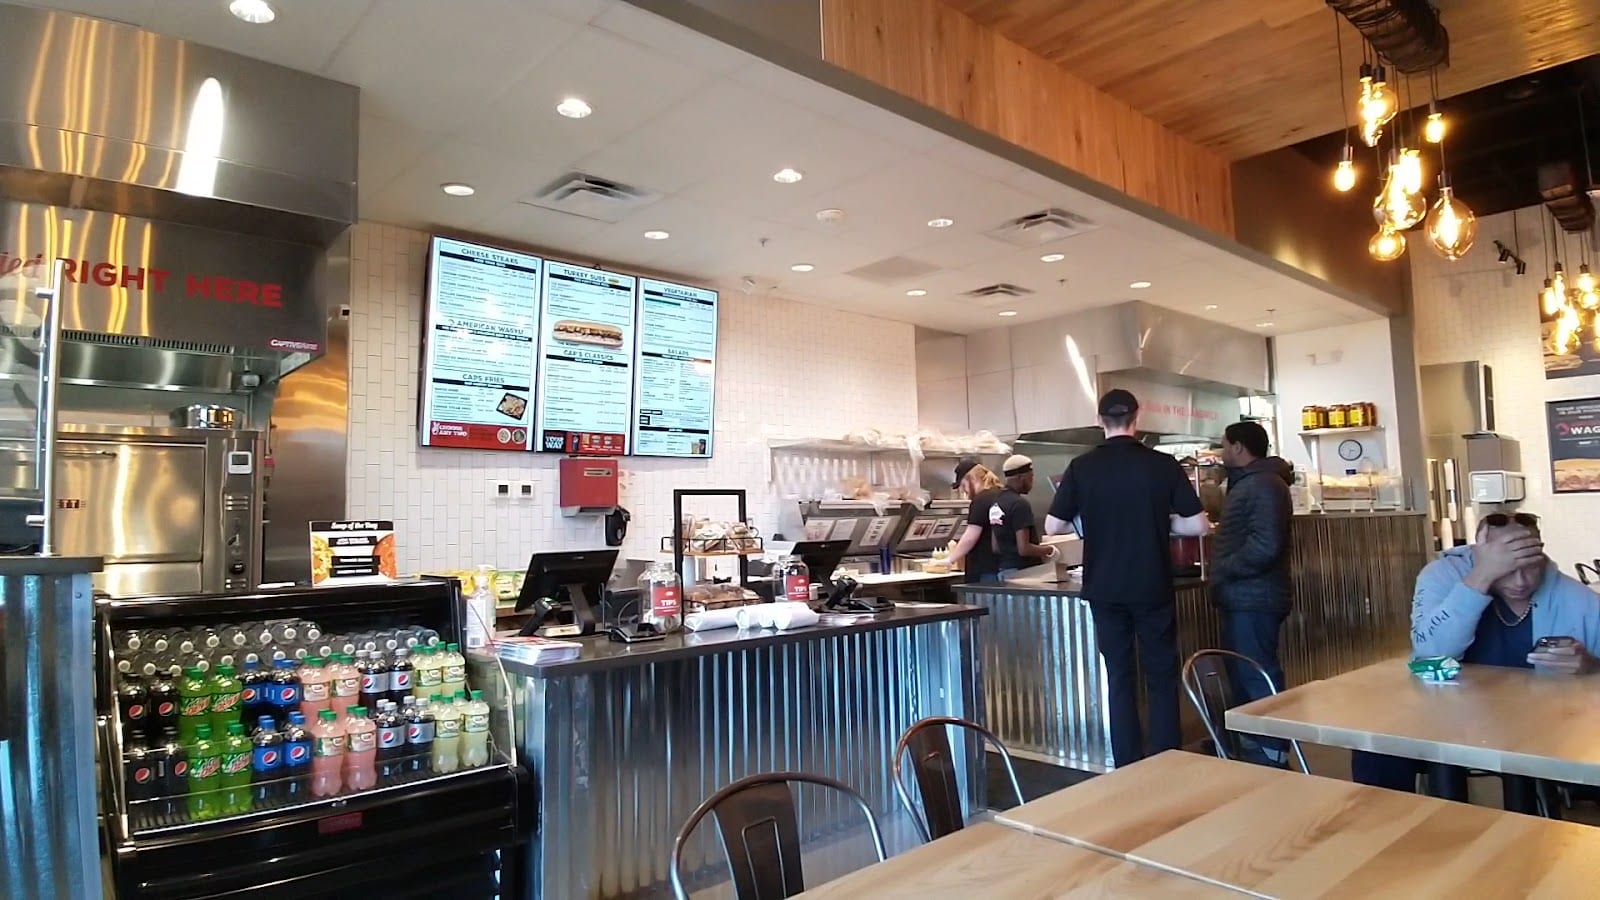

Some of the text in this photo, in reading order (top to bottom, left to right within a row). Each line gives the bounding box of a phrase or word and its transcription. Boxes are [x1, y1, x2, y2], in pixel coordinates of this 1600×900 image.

[462, 249, 489, 259] CHEESE
[492, 254, 519, 264] STEAKS
[564, 269, 588, 278] TURKEY
[590, 274, 606, 282] SUBS
[57, 258, 170, 293] RIGHT
[187, 274, 283, 308] HERE
[664, 287, 698, 297] VEGETARIAN
[457, 320, 496, 331] AMERICAN
[498, 326, 524, 335] WAGYU
[563, 349, 613, 361] CAP'S CLASSICS
[667, 348, 689, 356] SALADS
[485, 376, 505, 384] FRIES
[1173, 406, 1185, 416] THE
[545, 441, 563, 449] WAY
